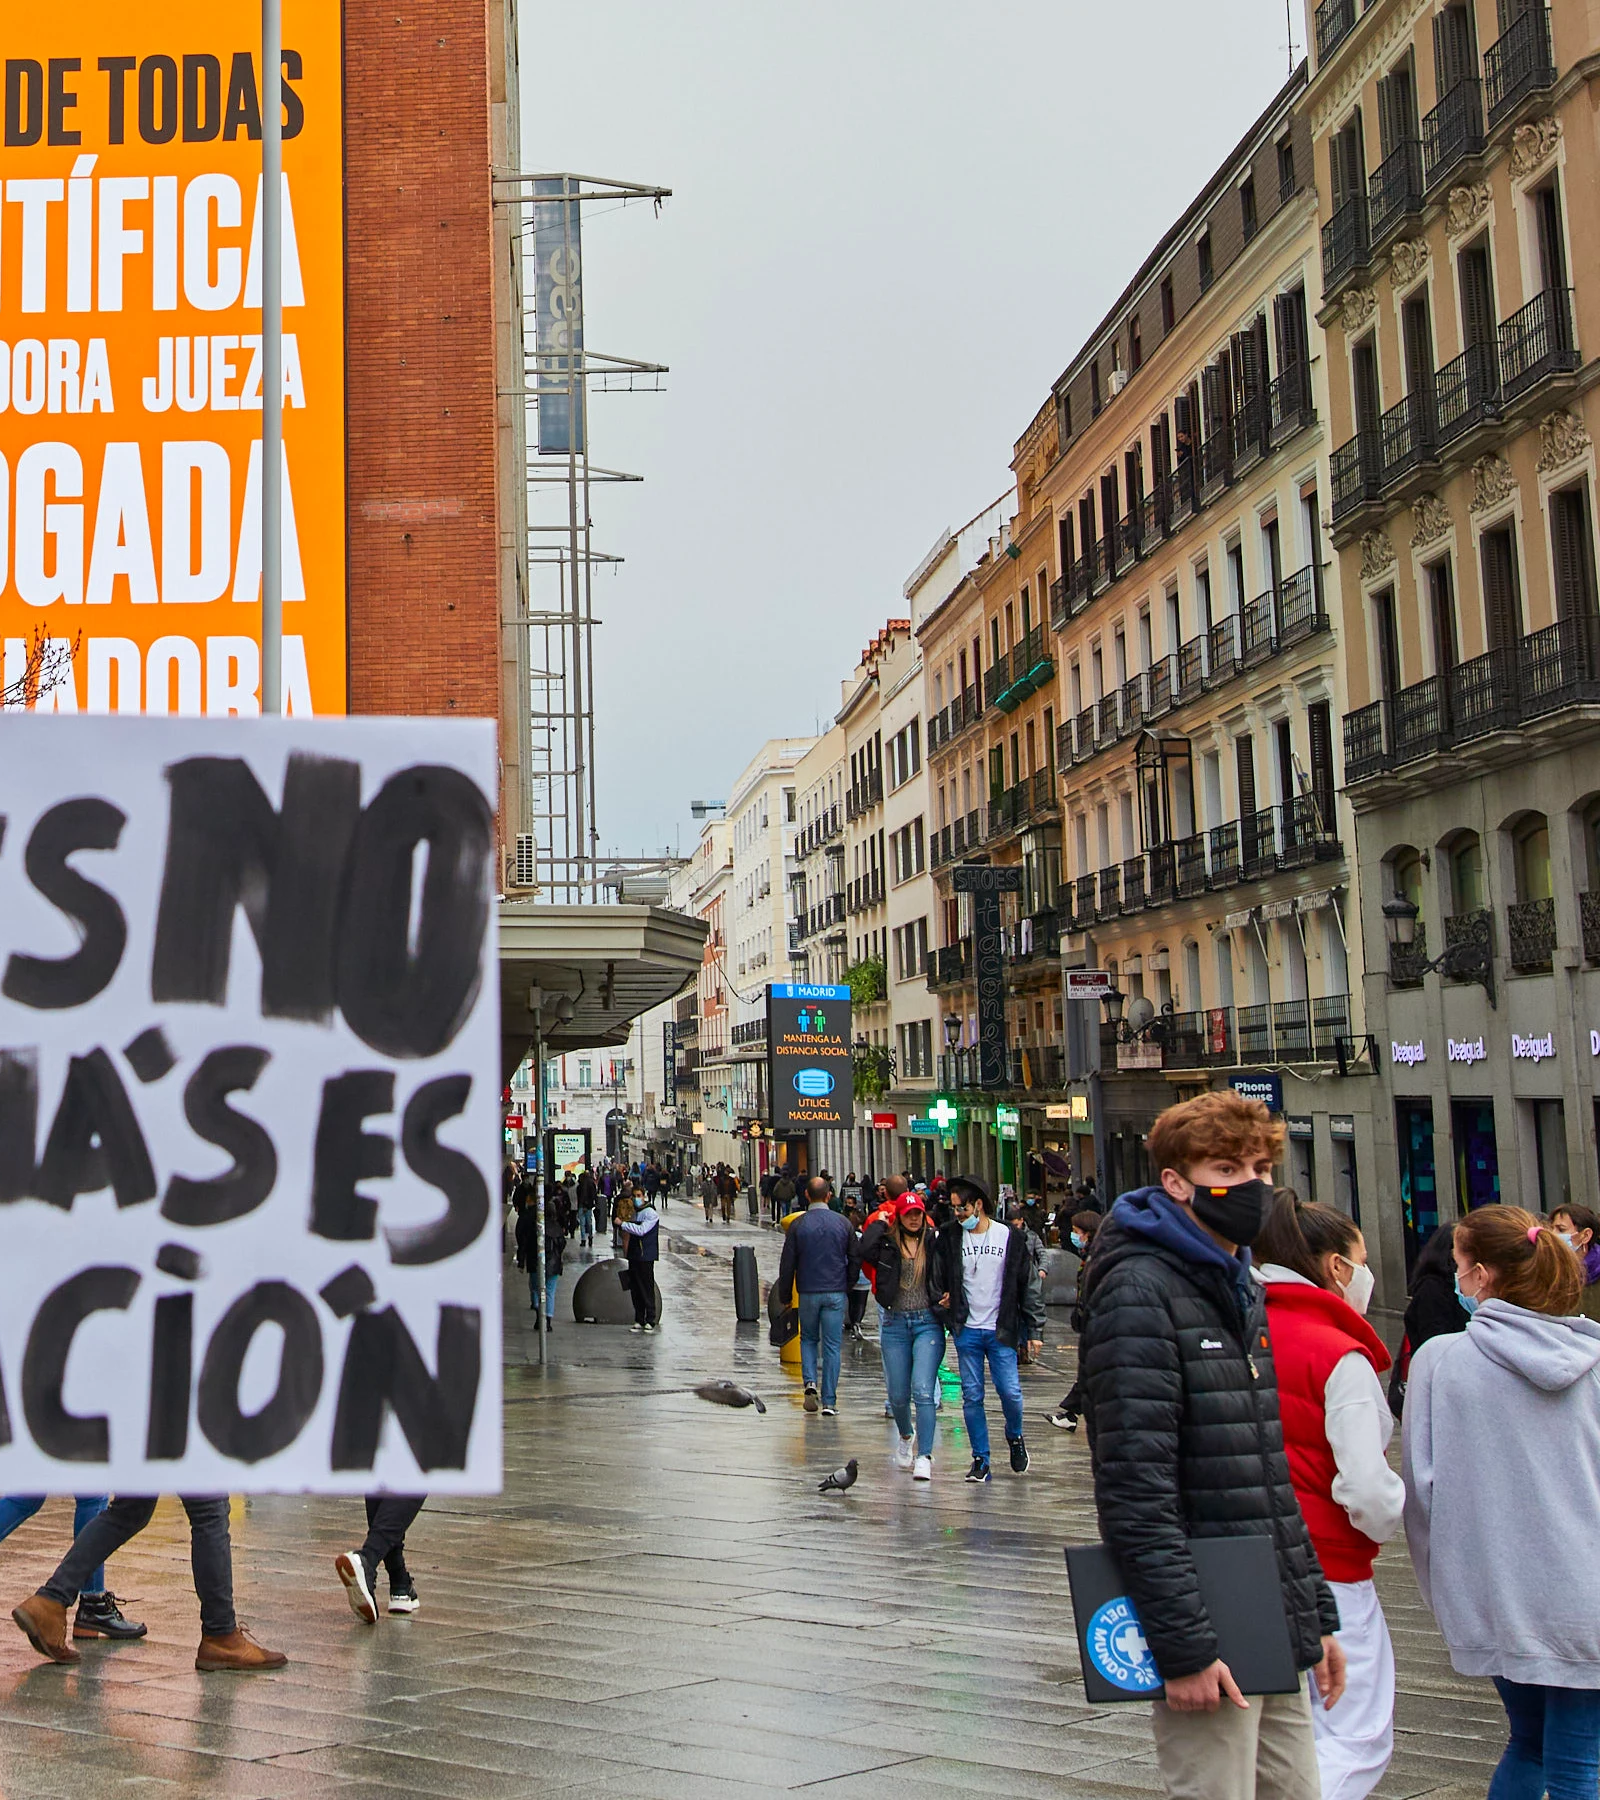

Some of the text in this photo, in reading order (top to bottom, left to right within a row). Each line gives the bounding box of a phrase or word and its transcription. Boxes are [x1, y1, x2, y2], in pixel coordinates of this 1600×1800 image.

[4, 58, 82, 147] DE
[97, 49, 305, 146] TODAS
[540, 248, 581, 384] fnac
[142, 333, 306, 413] JUEZA
[954, 869, 1019, 890] SHOES
[150, 748, 494, 1061] NO
[798, 987, 836, 997] MADRID
[783, 1034, 842, 1044] MANTENGA LA
[776, 1046, 849, 1057] DISTANCIA SOCIAL
[1234, 1082, 1273, 1092] Phone
[798, 1098, 830, 1108] UTILICE
[788, 1111, 841, 1121] MASCARILLA
[307, 1069, 491, 1265] ES
[1093, 1604, 1129, 1681] DEL MUNDO
